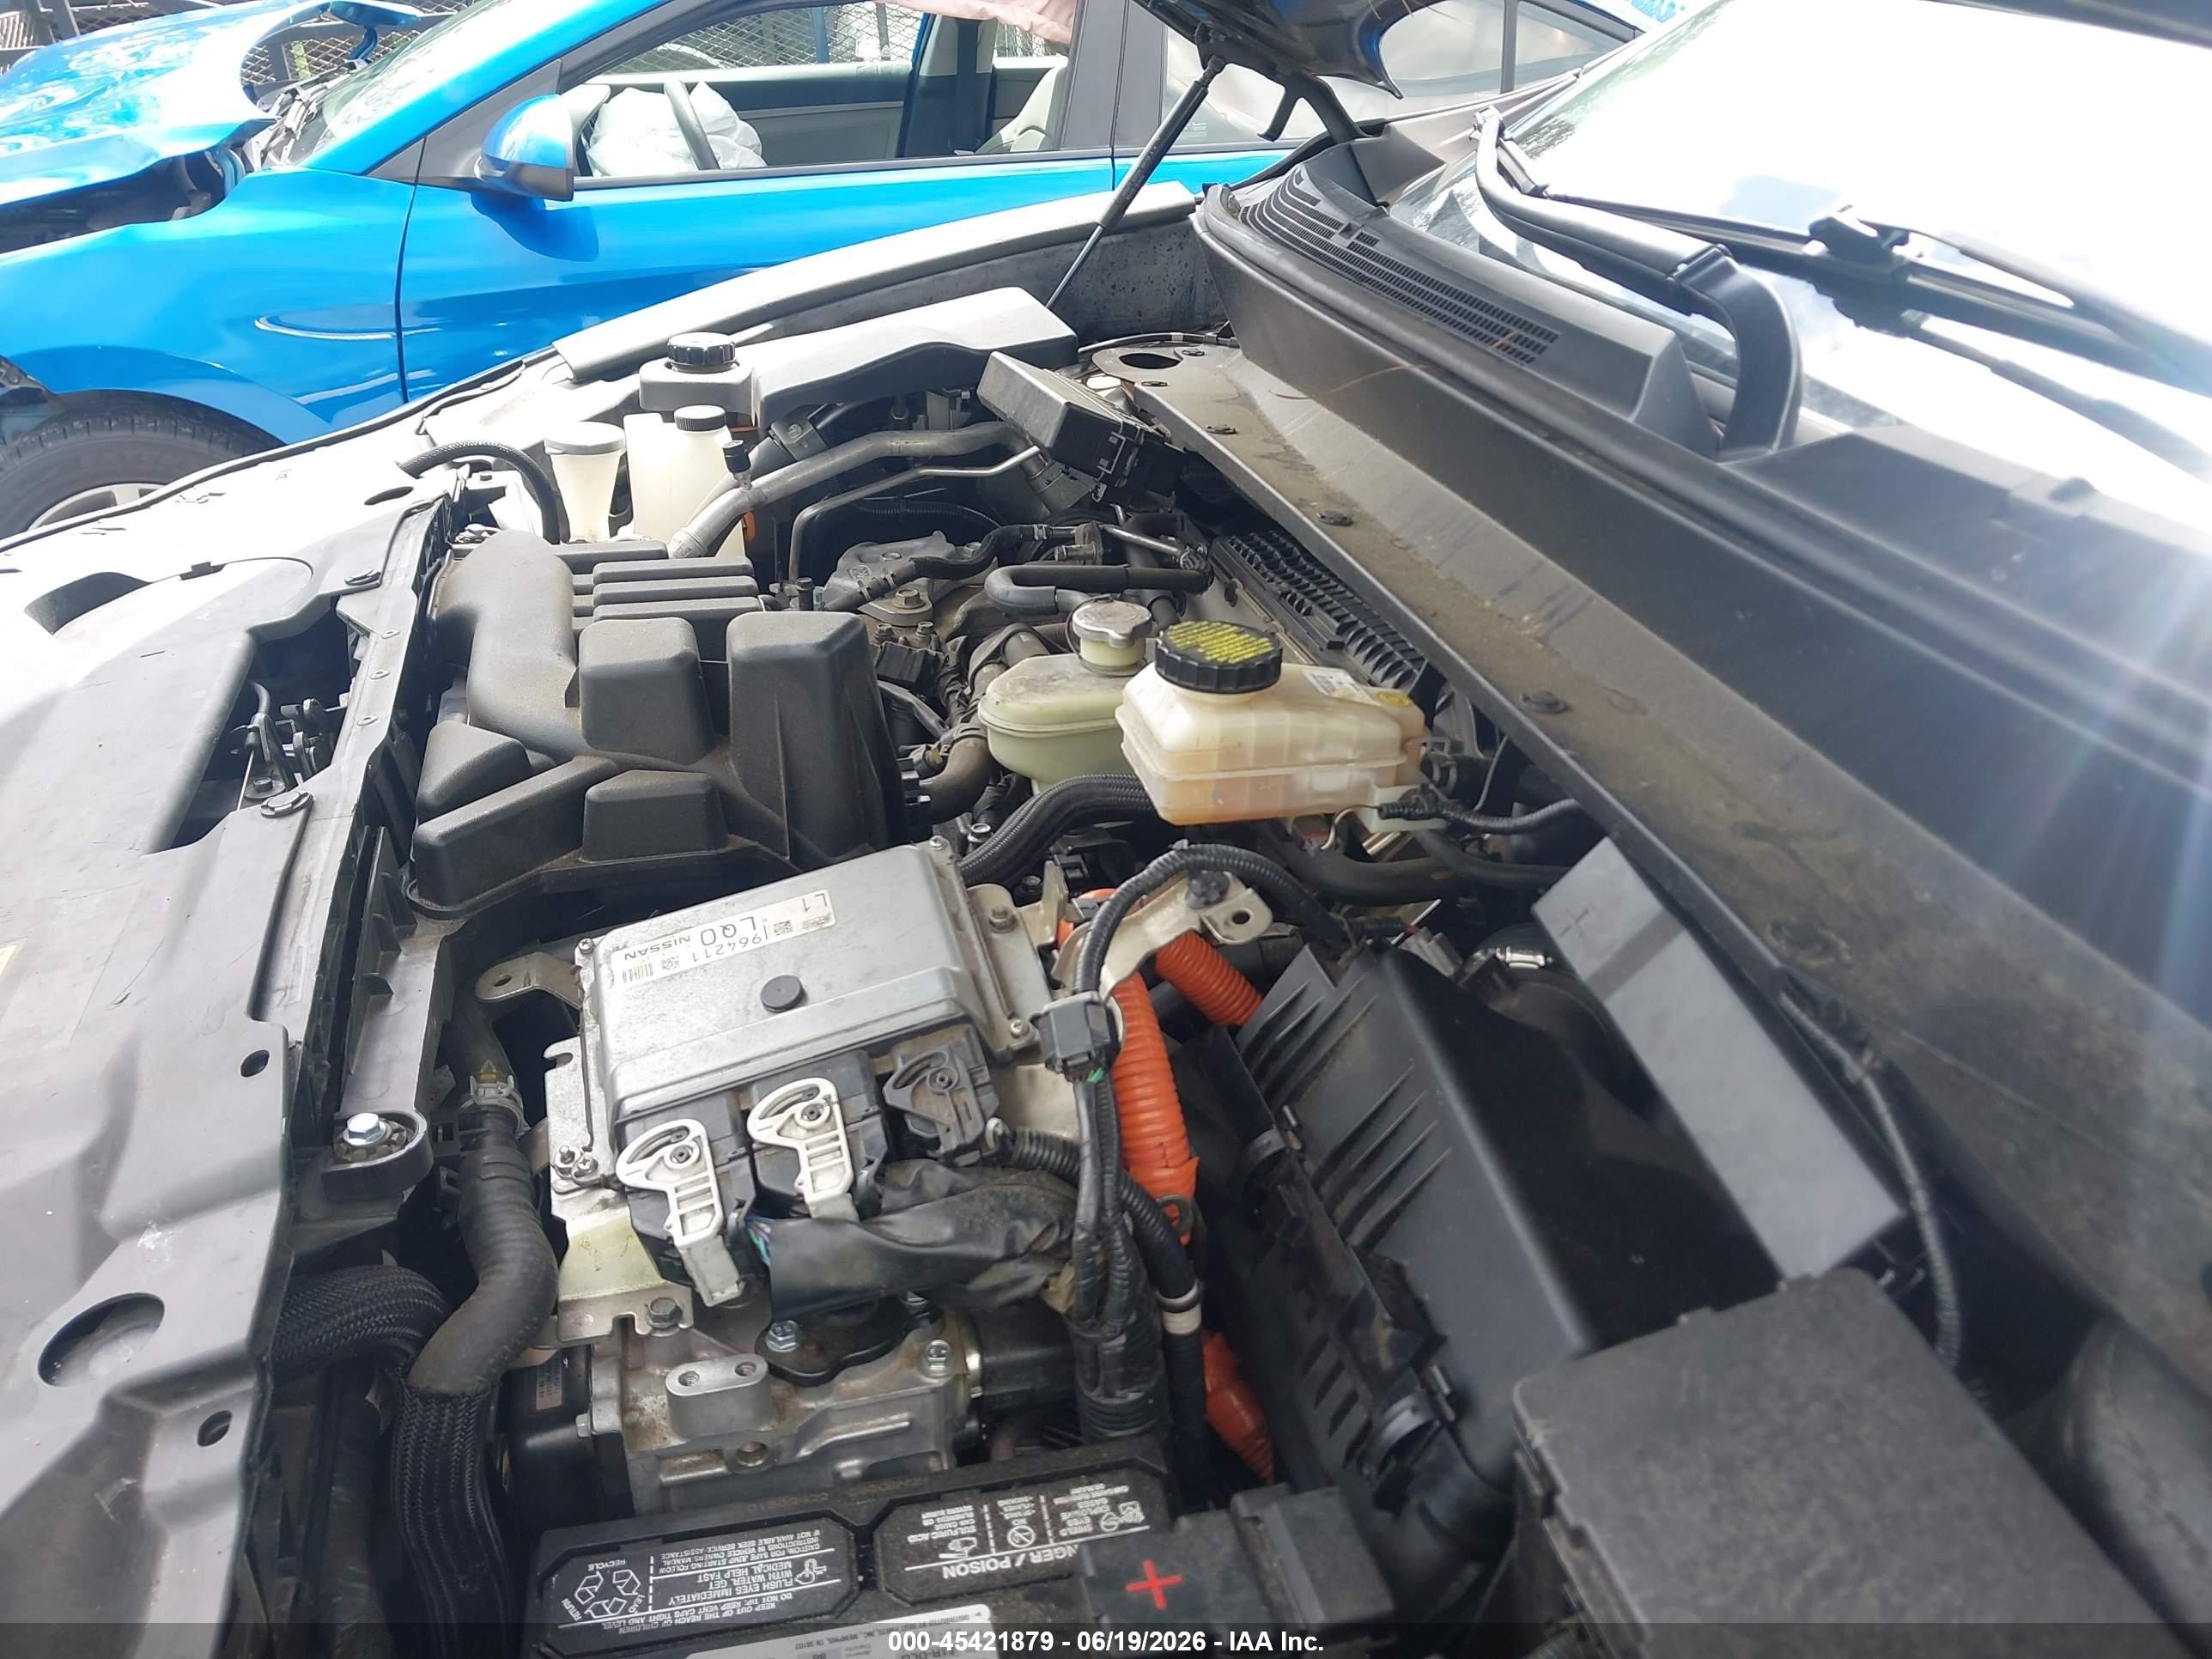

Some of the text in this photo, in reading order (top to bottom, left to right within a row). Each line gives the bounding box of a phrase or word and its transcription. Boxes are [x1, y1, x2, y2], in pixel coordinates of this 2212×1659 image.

[624, 935, 690, 961] NISSAN
[907, 1525, 976, 1542] SULFURIC ACID
[757, 1534, 794, 1546] AVAILABLE
[768, 1537, 818, 1551] INSTRUCTIONS
[707, 1543, 735, 1553] SERVICE
[726, 1547, 756, 1557] VEHICLE
[728, 1555, 749, 1564] JUMP
[750, 1552, 769, 1560] SAFE
[1030, 1544, 1079, 1564] NGER
[587, 1559, 625, 1571] RECYCLE
[659, 1564, 689, 1573] FOLLOW
[690, 1559, 726, 1570] STARTING
[943, 1556, 1012, 1578] POISON
[697, 1561, 792, 1583] MEDICAL HELP FAST
[769, 1570, 793, 1580] WITH
[708, 1579, 727, 1589] GET
[668, 1578, 793, 1606] FLUSH EYES IMMEDIATELY
[629, 1594, 645, 1613] LEAD
[762, 1595, 778, 1603] NOT
[562, 1598, 582, 1621] RETURN
[698, 1605, 719, 1613] VENT
[736, 1606, 752, 1614] OUT
[756, 1602, 775, 1611] KEEP
[649, 1613, 672, 1622] TIGHT
[674, 1607, 696, 1618] CAPS
[629, 1616, 646, 1625] AND
[675, 1614, 701, 1626] REACH
[618, 1621, 659, 1634] CHILDREN
